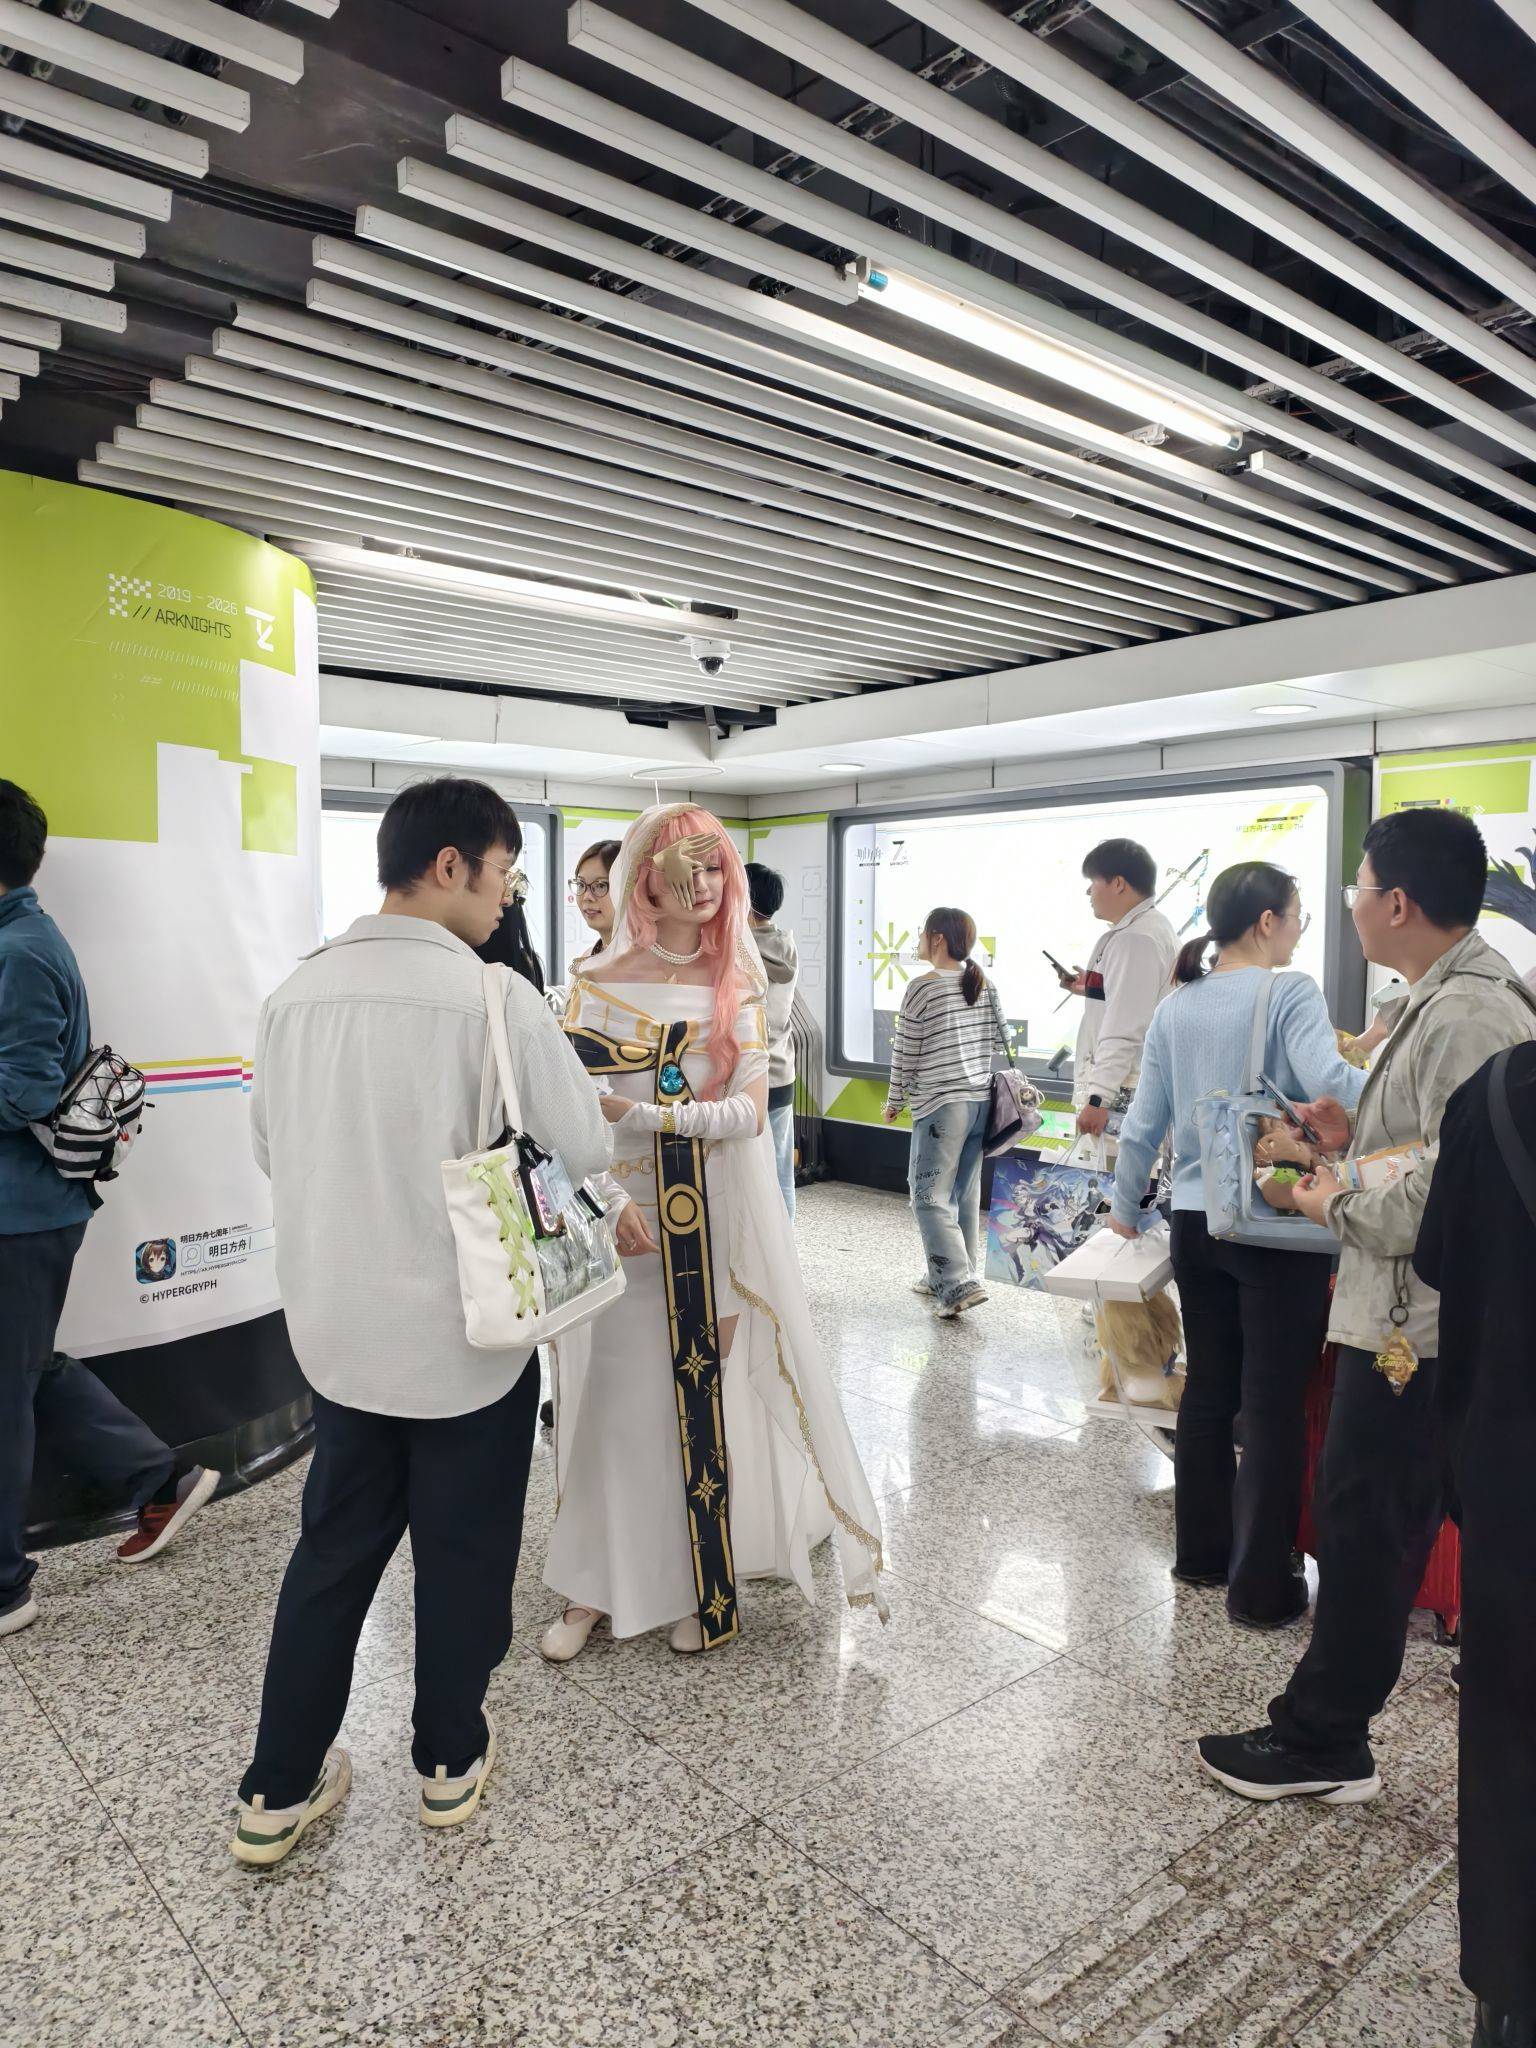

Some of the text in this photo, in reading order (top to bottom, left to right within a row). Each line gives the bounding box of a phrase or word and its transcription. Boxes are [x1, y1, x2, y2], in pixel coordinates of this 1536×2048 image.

[158, 583, 191, 603] 2019
[206, 595, 238, 616] 2026
[155, 608, 232, 639] ARKNIGHTS
[801, 864, 824, 988] ISLAND
[180, 1227, 229, 1243] 明日方舟七周年
[209, 1238, 246, 1257] 明日方舟
[152, 1279, 217, 1302] HYPERGRYPH
